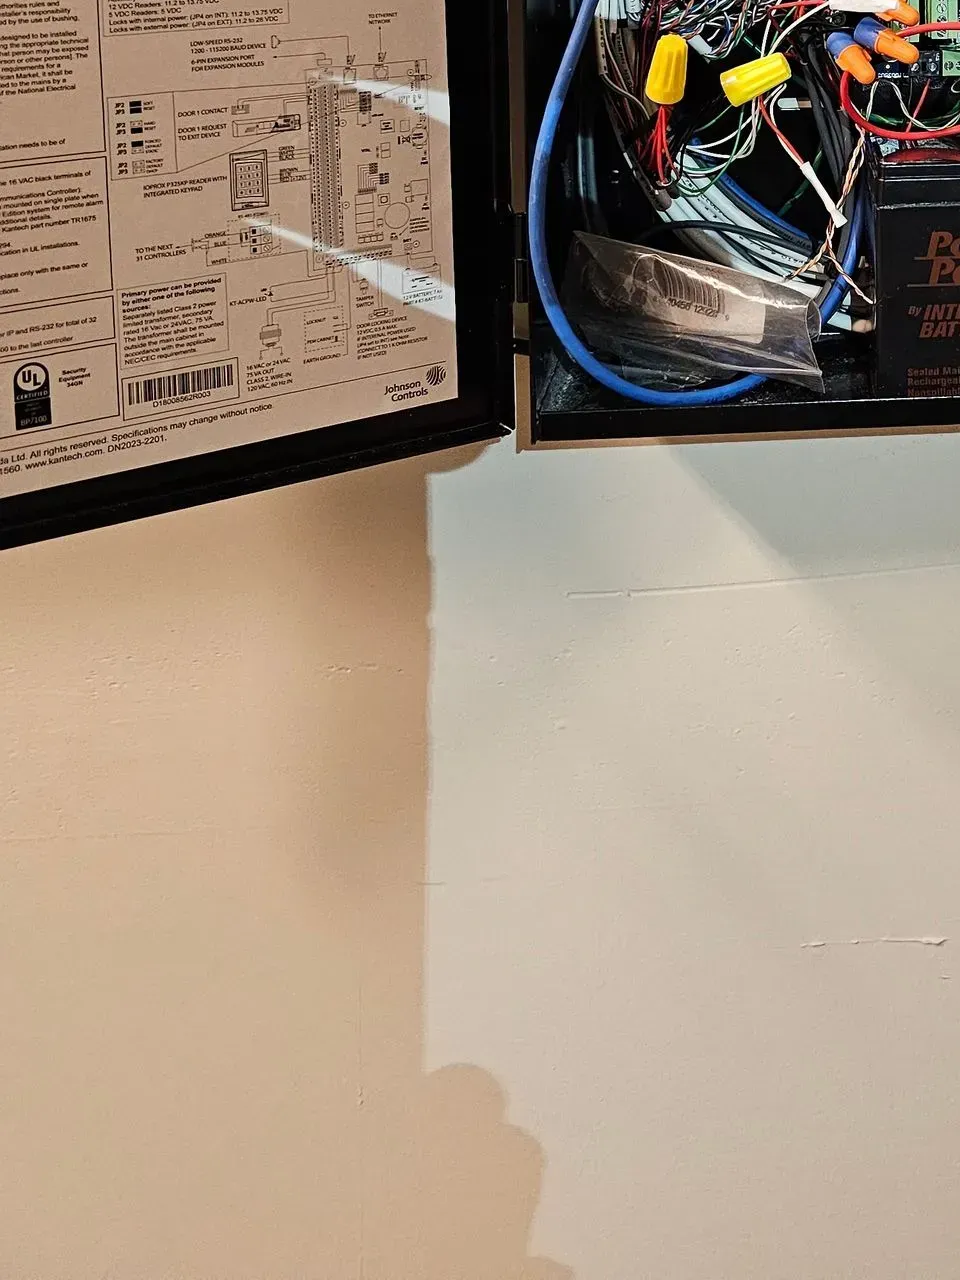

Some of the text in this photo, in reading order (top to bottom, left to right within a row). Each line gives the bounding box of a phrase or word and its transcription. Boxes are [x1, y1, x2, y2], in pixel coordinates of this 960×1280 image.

[144, 250, 186, 260] CONTROLLERS
[122, 290, 147, 299] Primary
[149, 286, 169, 295] power
[194, 278, 221, 288] provided
[908, 305, 922, 317] By
[59, 373, 91, 383] Equipment
[907, 367, 939, 376] Sealed
[384, 380, 421, 395] Johnson
[391, 387, 428, 402] Controls
[30, 450, 41, 459] All
[43, 446, 68, 456] rights
[112, 426, 168, 442] Specifications
[170, 421, 188, 431] may
[189, 414, 218, 428] change
[220, 408, 258, 419] without
[250, 403, 273, 413] notice
